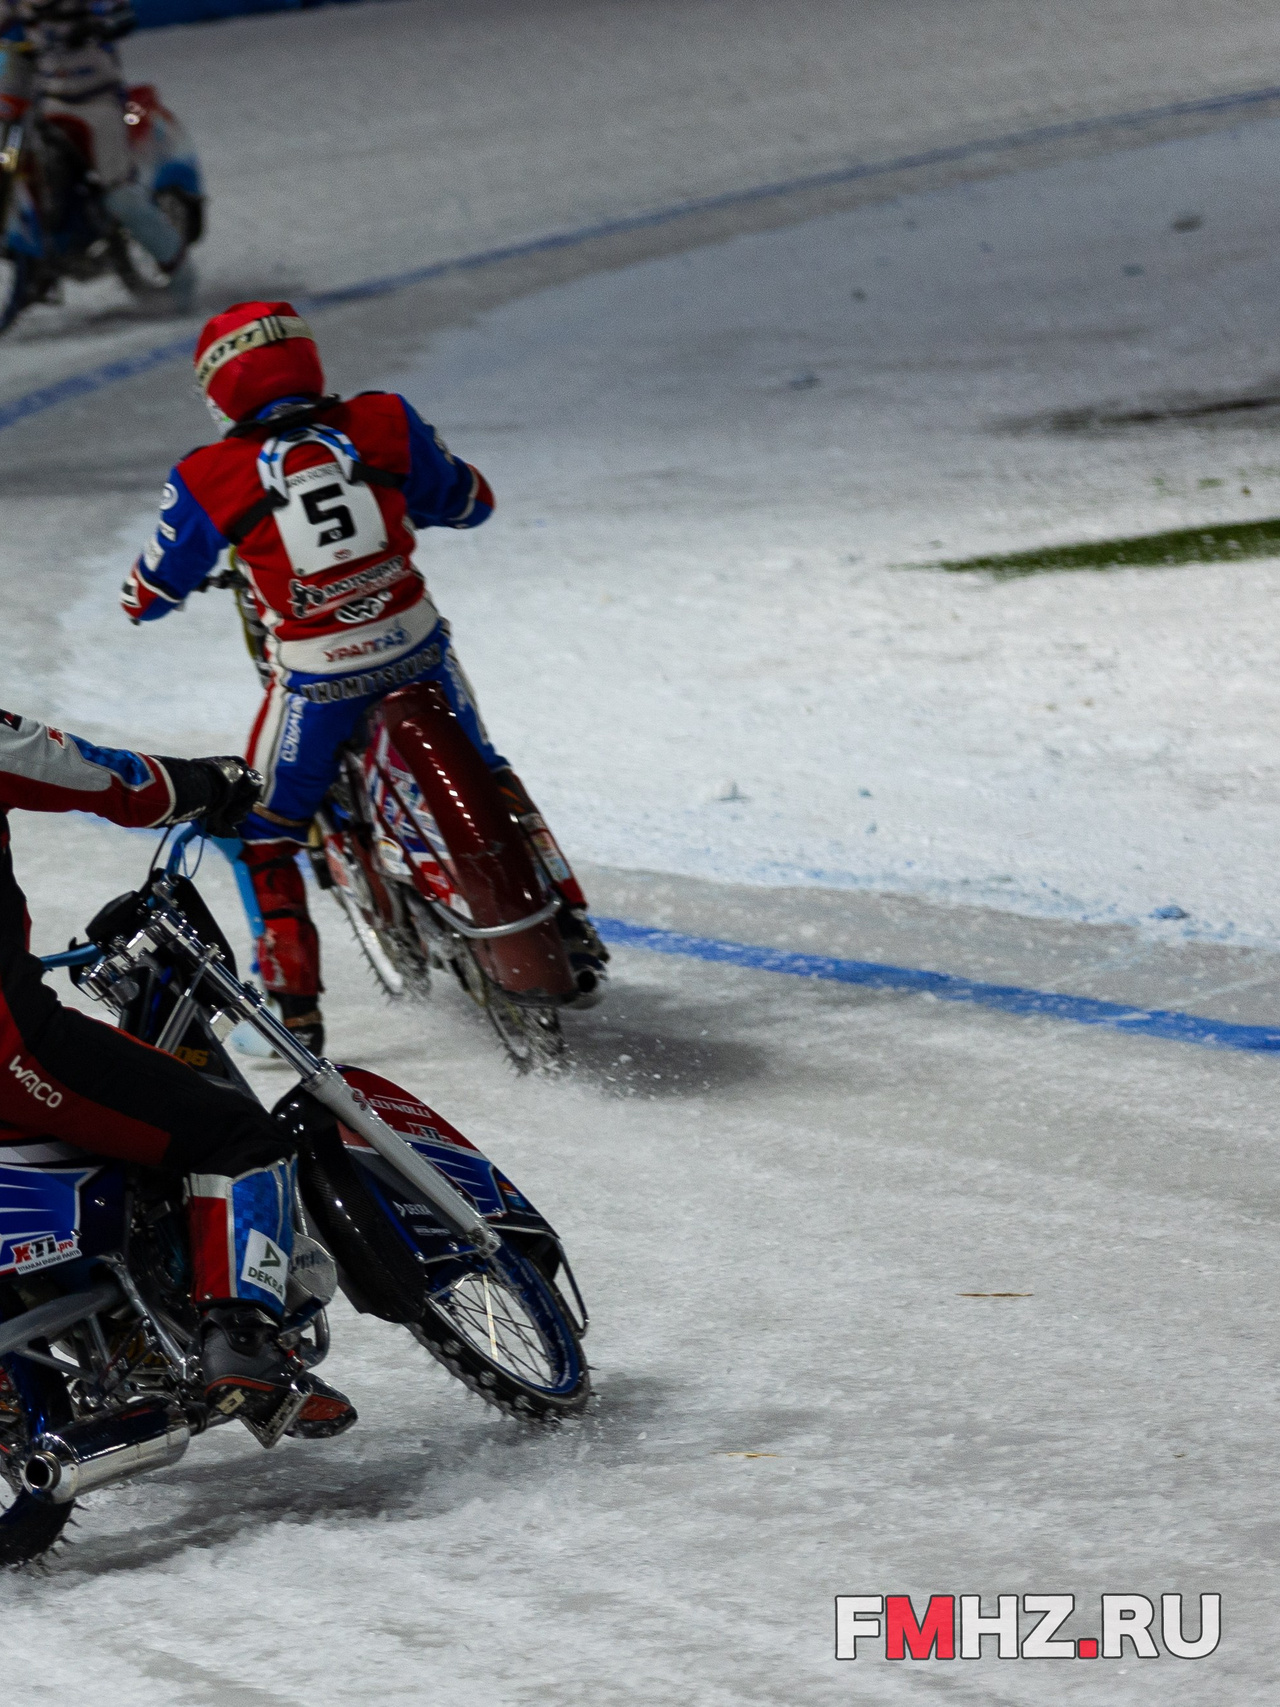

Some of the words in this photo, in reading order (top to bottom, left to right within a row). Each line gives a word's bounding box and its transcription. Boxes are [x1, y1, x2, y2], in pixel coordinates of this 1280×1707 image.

[300, 483, 357, 547] 5
[9, 1055, 63, 1108] WACO
[248, 1266, 285, 1295] DEKRA
